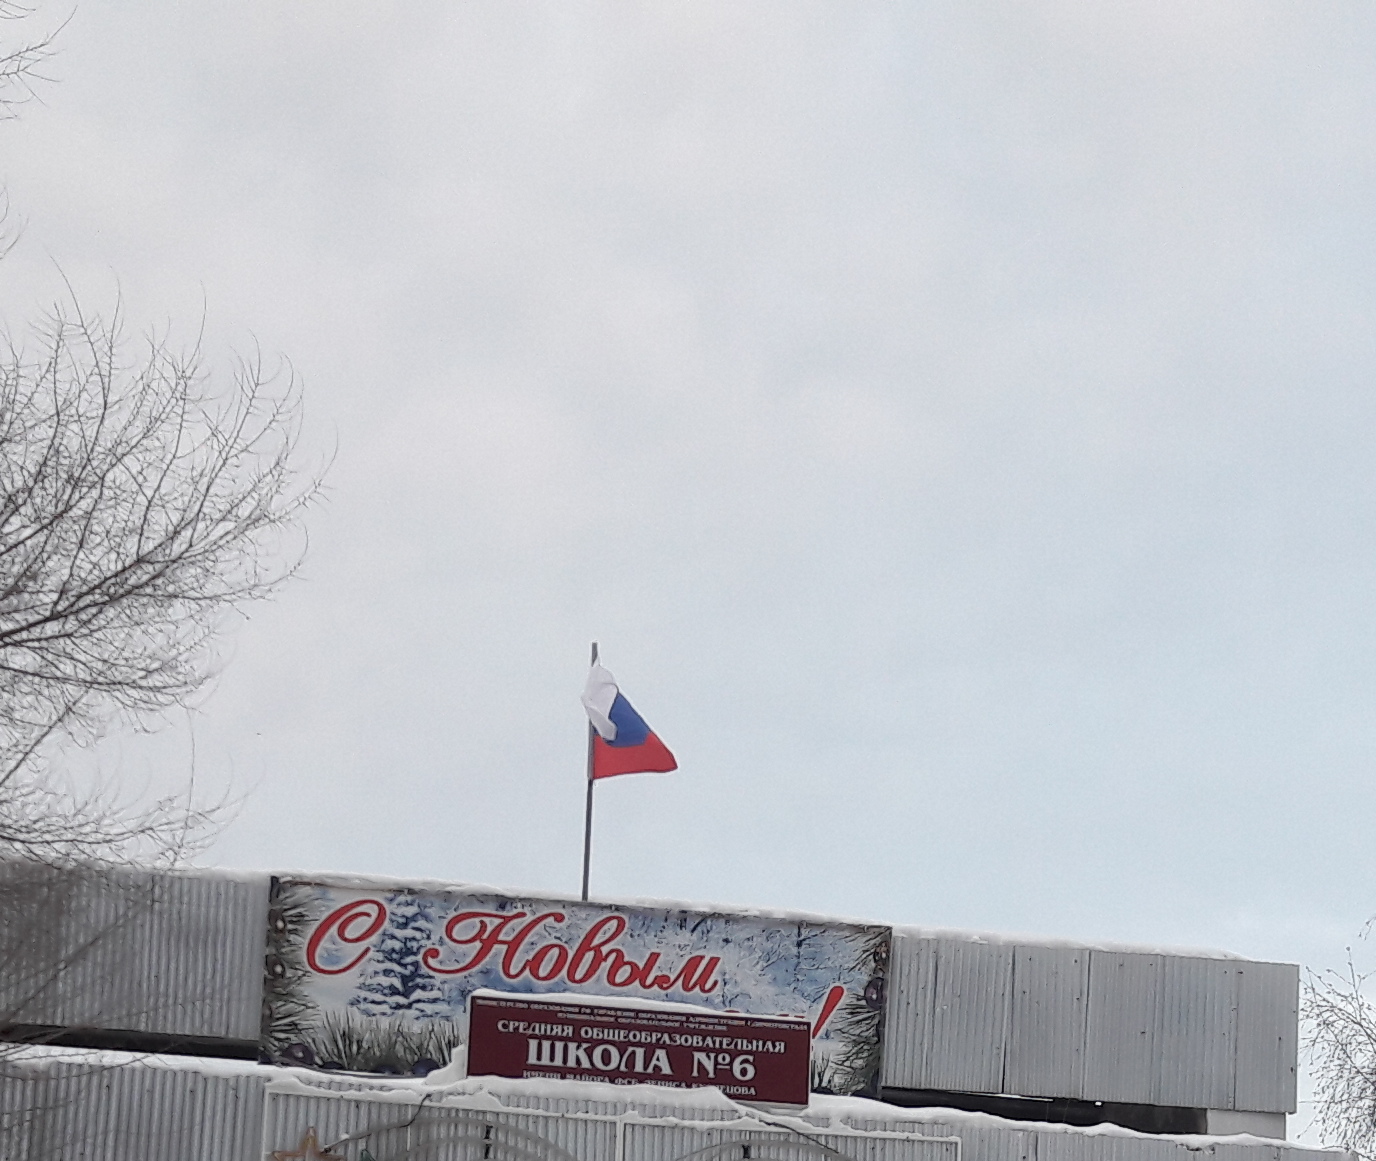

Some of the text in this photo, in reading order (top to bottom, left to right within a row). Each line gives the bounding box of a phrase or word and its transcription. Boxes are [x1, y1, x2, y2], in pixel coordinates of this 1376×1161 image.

[306, 899, 721, 993] С Новым
[497, 1019, 574, 1038] СРЕДНЯЯ
[580, 1026, 786, 1054] ОБЩЕОБРАЗОВАТЕЛЬНАЯ
[526, 1038, 756, 1081] ШКОЛА №6
